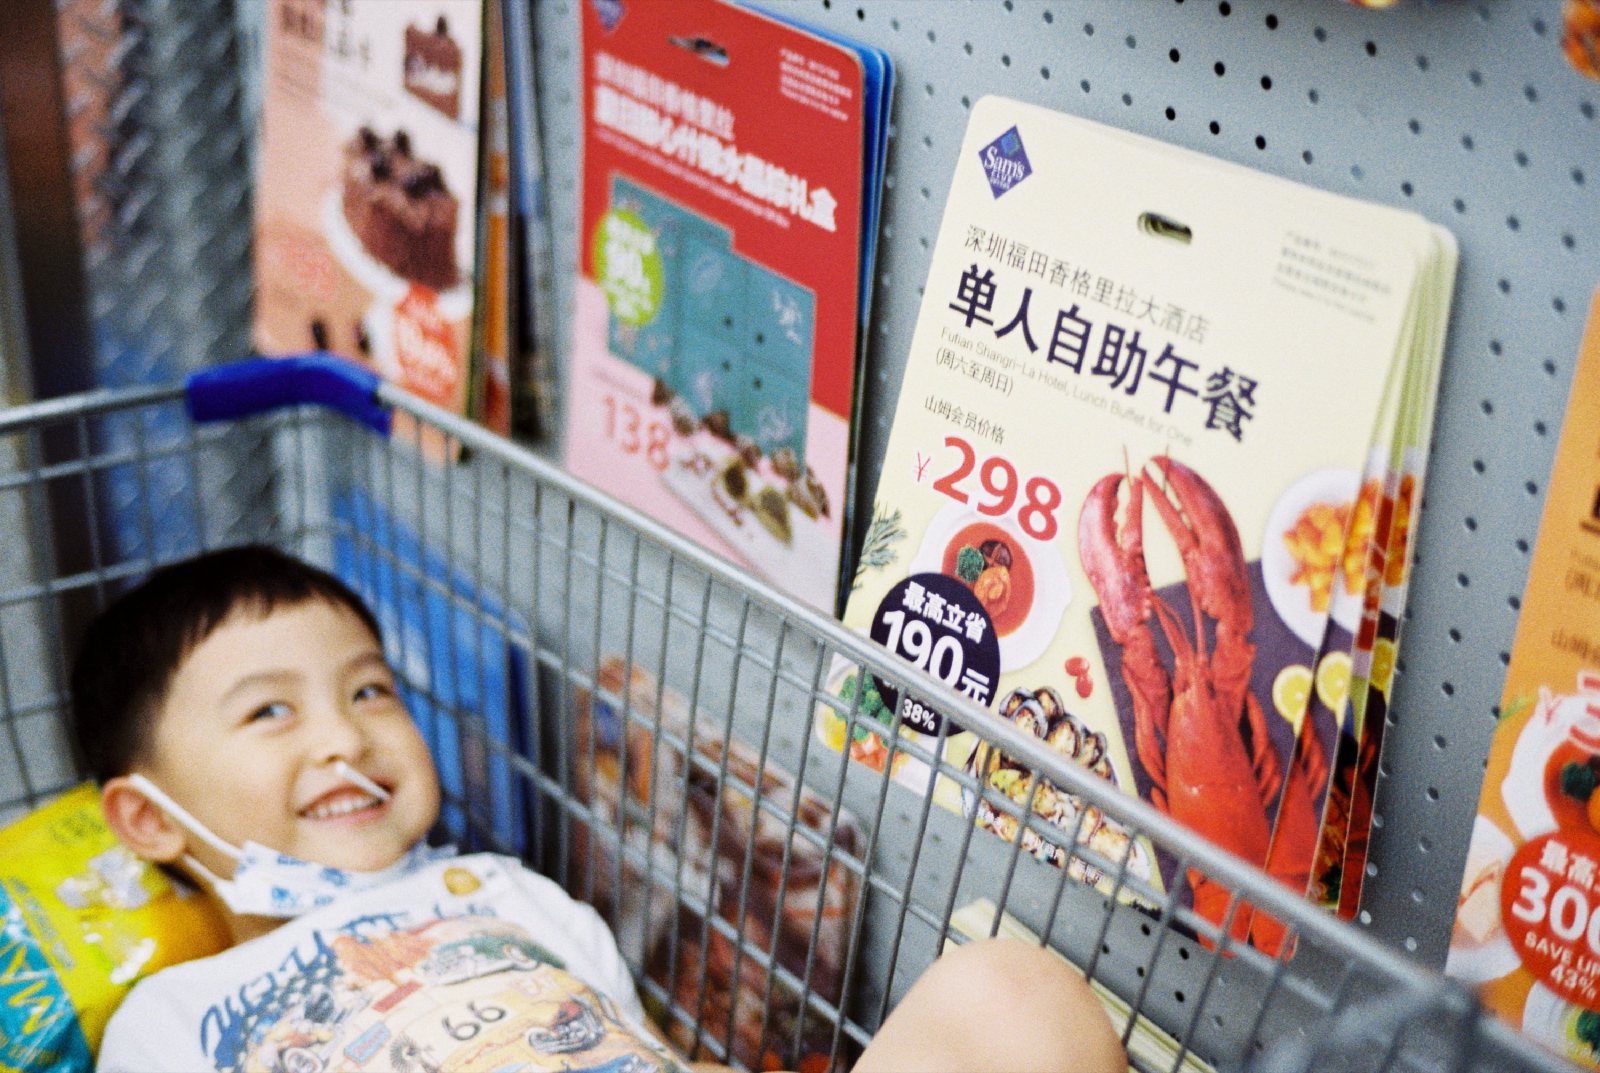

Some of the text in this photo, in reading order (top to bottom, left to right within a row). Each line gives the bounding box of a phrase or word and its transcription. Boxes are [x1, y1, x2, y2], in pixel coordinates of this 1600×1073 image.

[984, 145, 1025, 180] Sam's
[964, 223, 1210, 345] 深圳福田香格里拉大酒店
[936, 347, 1014, 396] (周六至周日)
[941, 326, 973, 350] Futian
[975, 341, 1036, 378] Shangri-La
[1072, 384, 1107, 408] Lunch
[948, 263, 1260, 443] 单人自助午餐
[924, 394, 1006, 445] 山姆会员价格
[902, 581, 987, 644] 最高立省
[902, 698, 936, 731] 38%
[1524, 931, 1572, 967] SAVE
[1551, 964, 1597, 1000] 43%
[442, 1000, 507, 1041] 66
